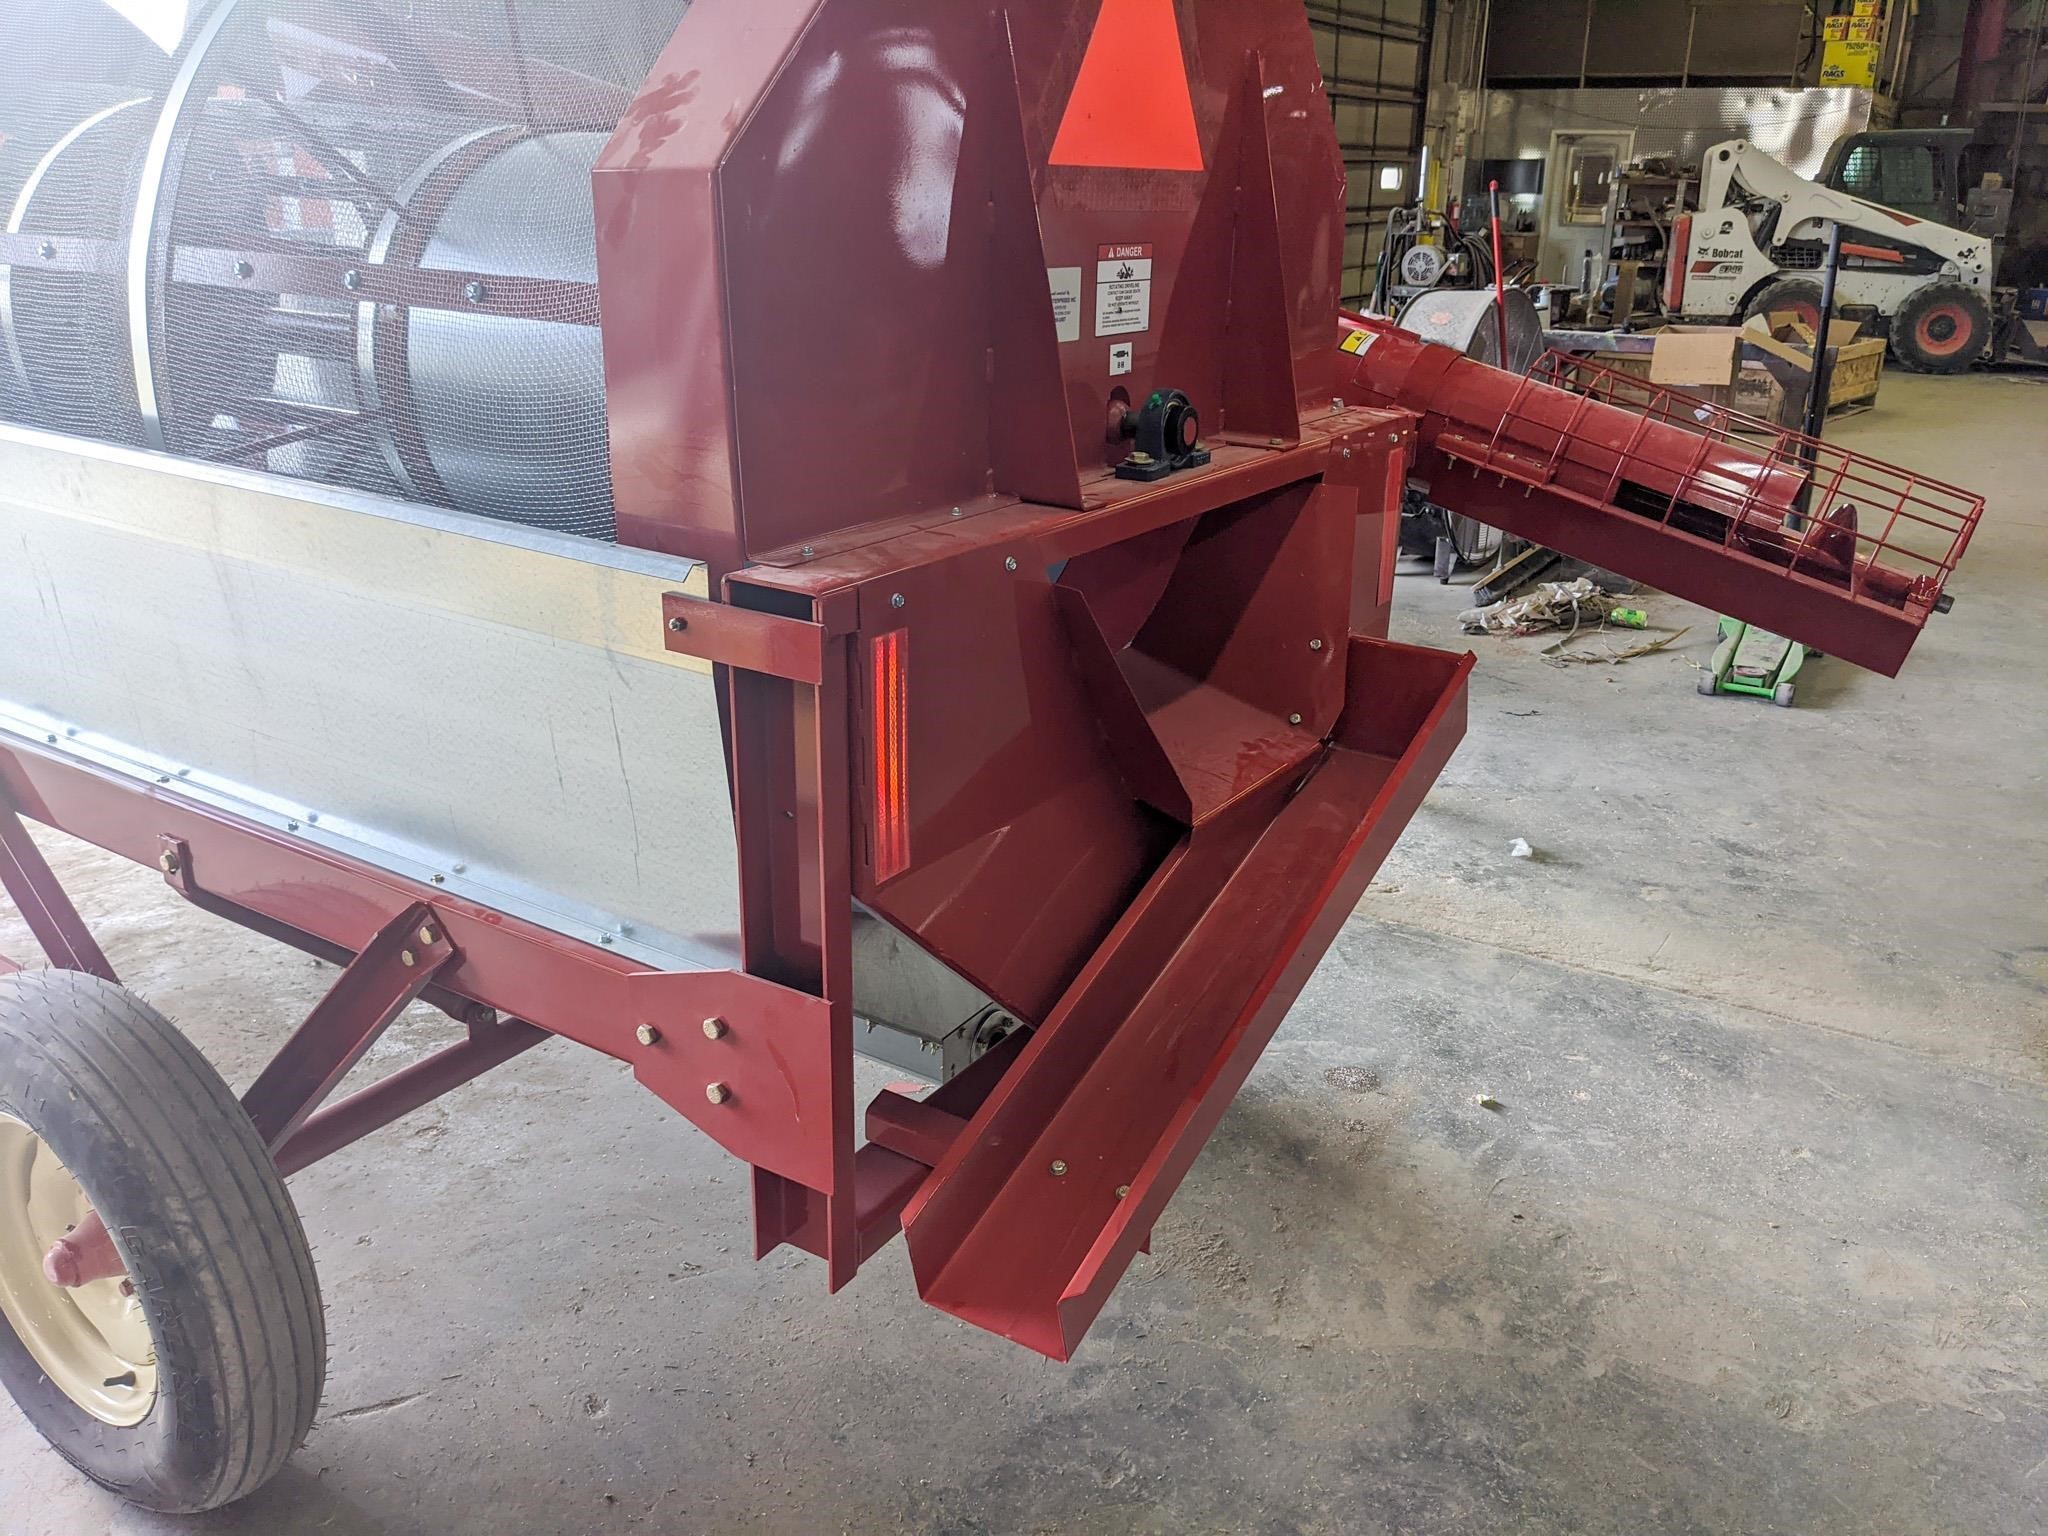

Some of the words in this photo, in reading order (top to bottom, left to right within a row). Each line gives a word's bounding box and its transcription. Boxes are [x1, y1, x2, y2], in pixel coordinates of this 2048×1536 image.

[1719, 221, 1733, 234] 2
[1116, 247, 1142, 257] DANGER
[1712, 248, 1743, 258] Bobcat
